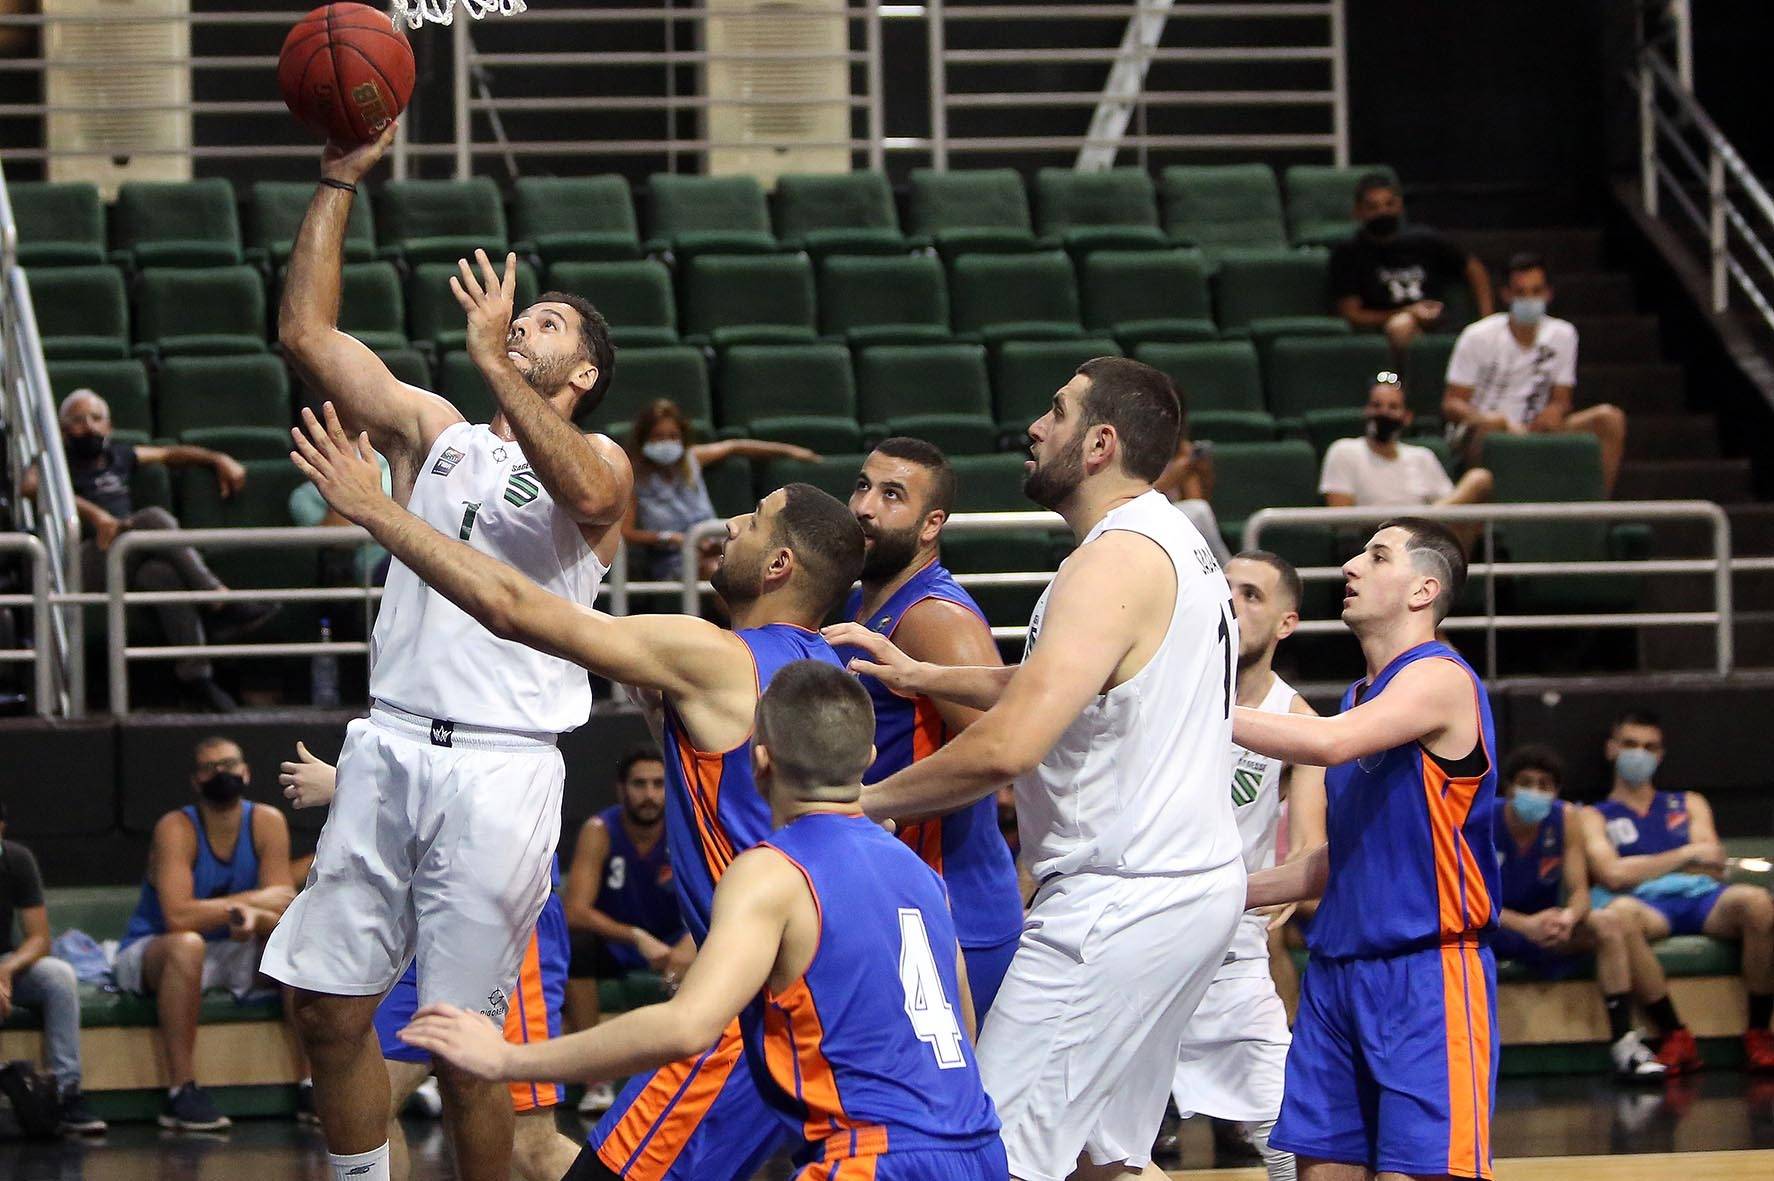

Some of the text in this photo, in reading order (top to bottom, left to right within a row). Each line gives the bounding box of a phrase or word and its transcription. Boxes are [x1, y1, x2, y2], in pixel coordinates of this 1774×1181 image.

[1218, 598, 1239, 720] 1
[607, 855, 626, 890] 3
[898, 907, 967, 1070] 4
